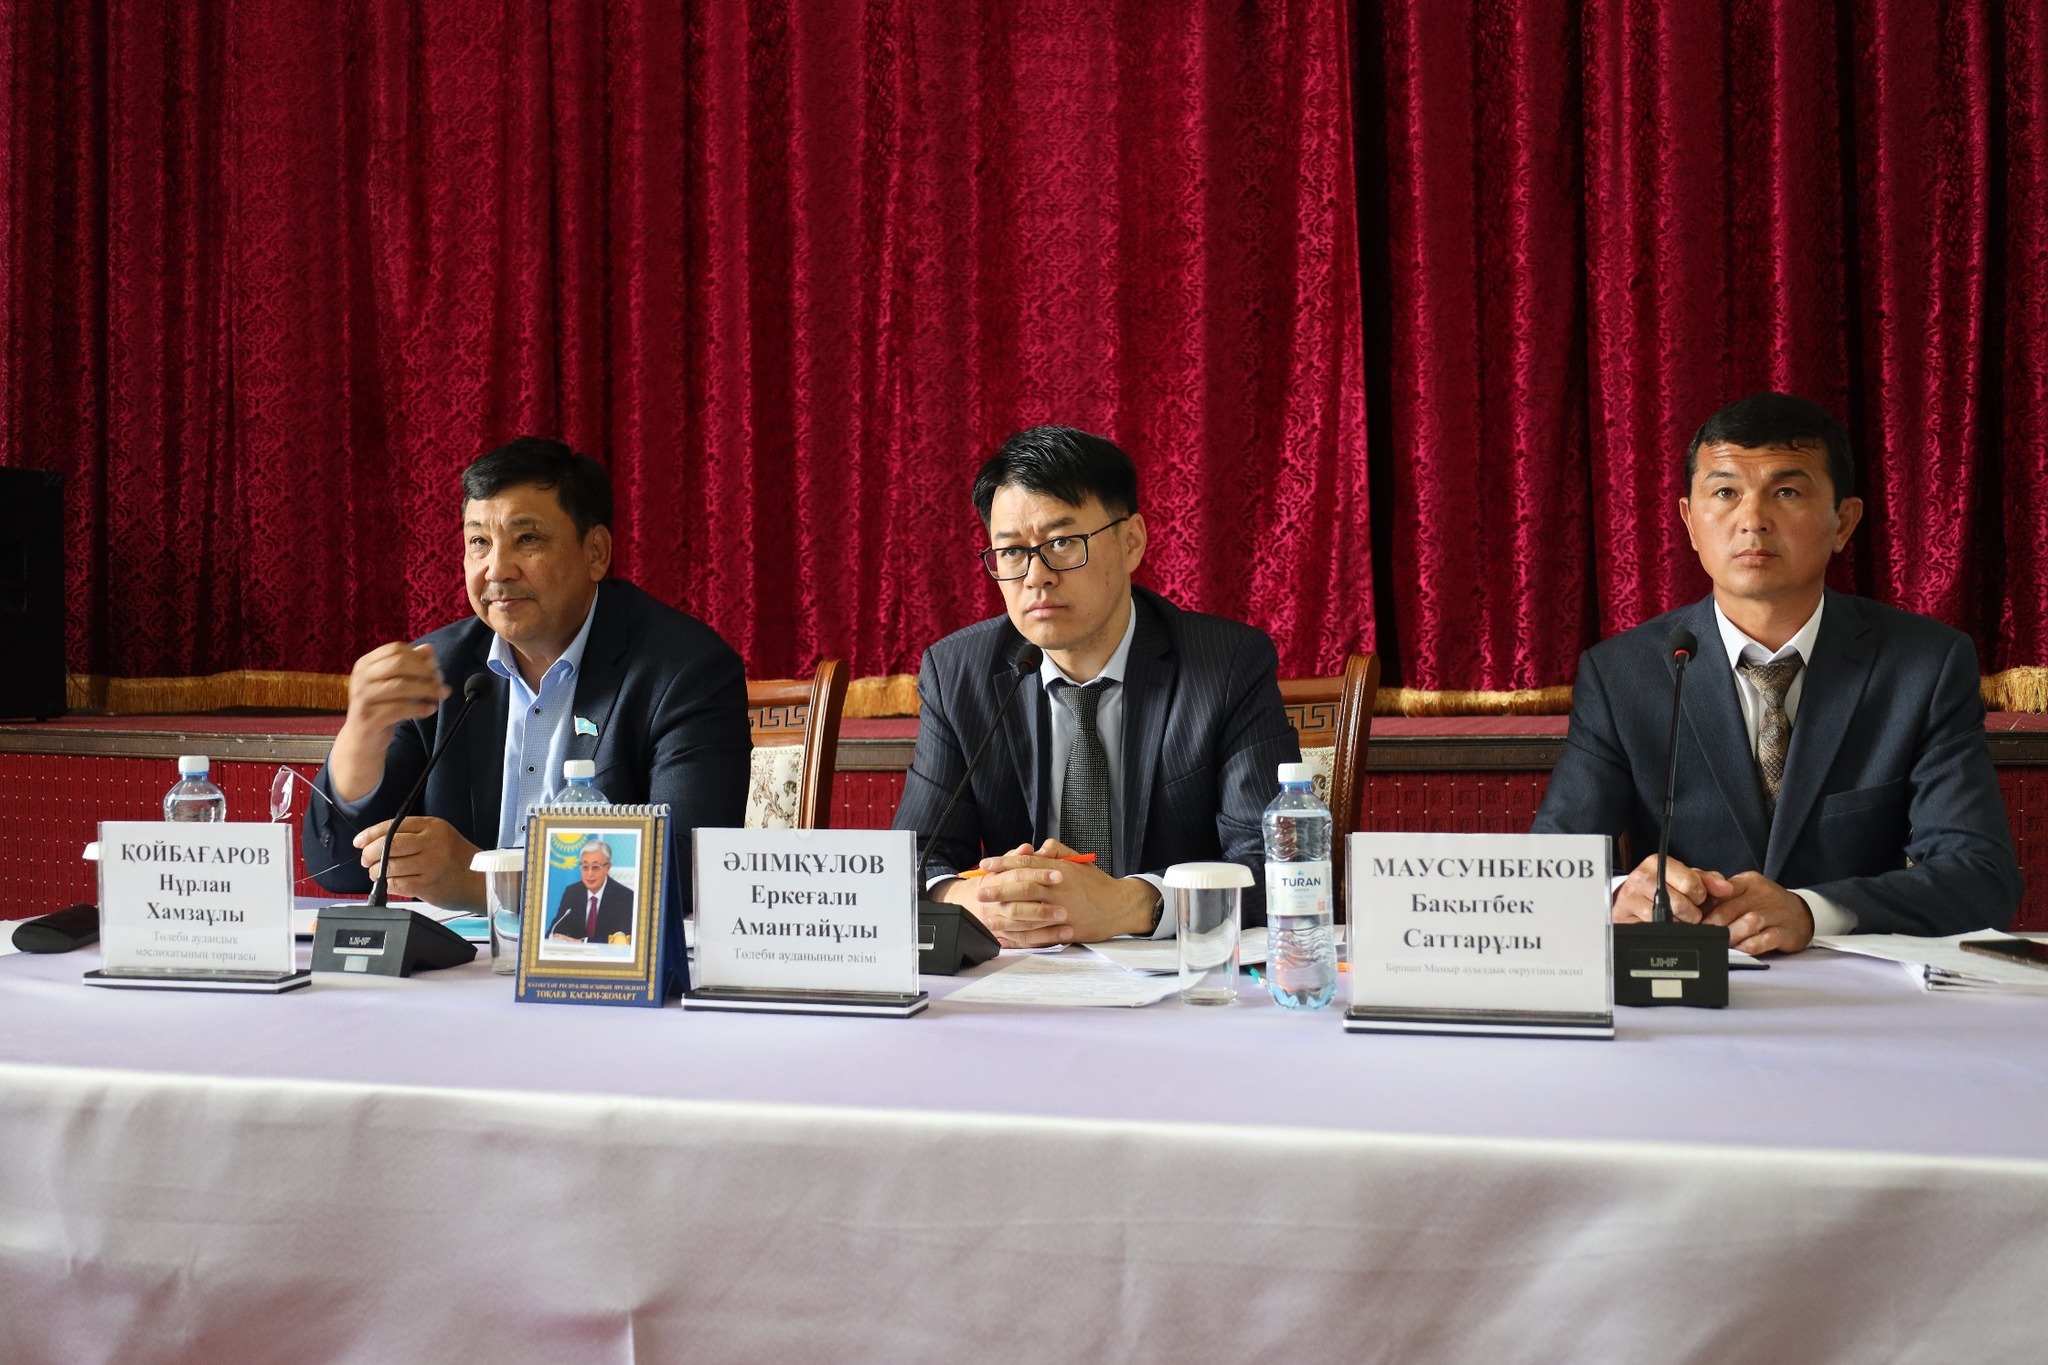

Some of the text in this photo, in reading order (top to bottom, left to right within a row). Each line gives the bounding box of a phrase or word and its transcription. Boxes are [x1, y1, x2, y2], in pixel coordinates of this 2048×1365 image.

[121, 840, 270, 865] ҚОЙБАҒАРОВ
[723, 852, 885, 877] ӘЛІМҚҰЛОВ
[1372, 857, 1595, 879] МАУСУНБЕКОВ
[159, 873, 231, 896] Нұрлан
[1282, 877, 1321, 887] TURAN
[751, 884, 857, 909] Еркеғали
[1411, 893, 1534, 915] Бақытбек
[146, 902, 244, 926] Хамзаұлы
[731, 916, 878, 943] Амантайұлы
[1403, 928, 1542, 954] Саттарұлы
[733, 947, 775, 961] Төлеби
[847, 953, 877, 965] әкімі
[1650, 957, 1678, 967] UHF
